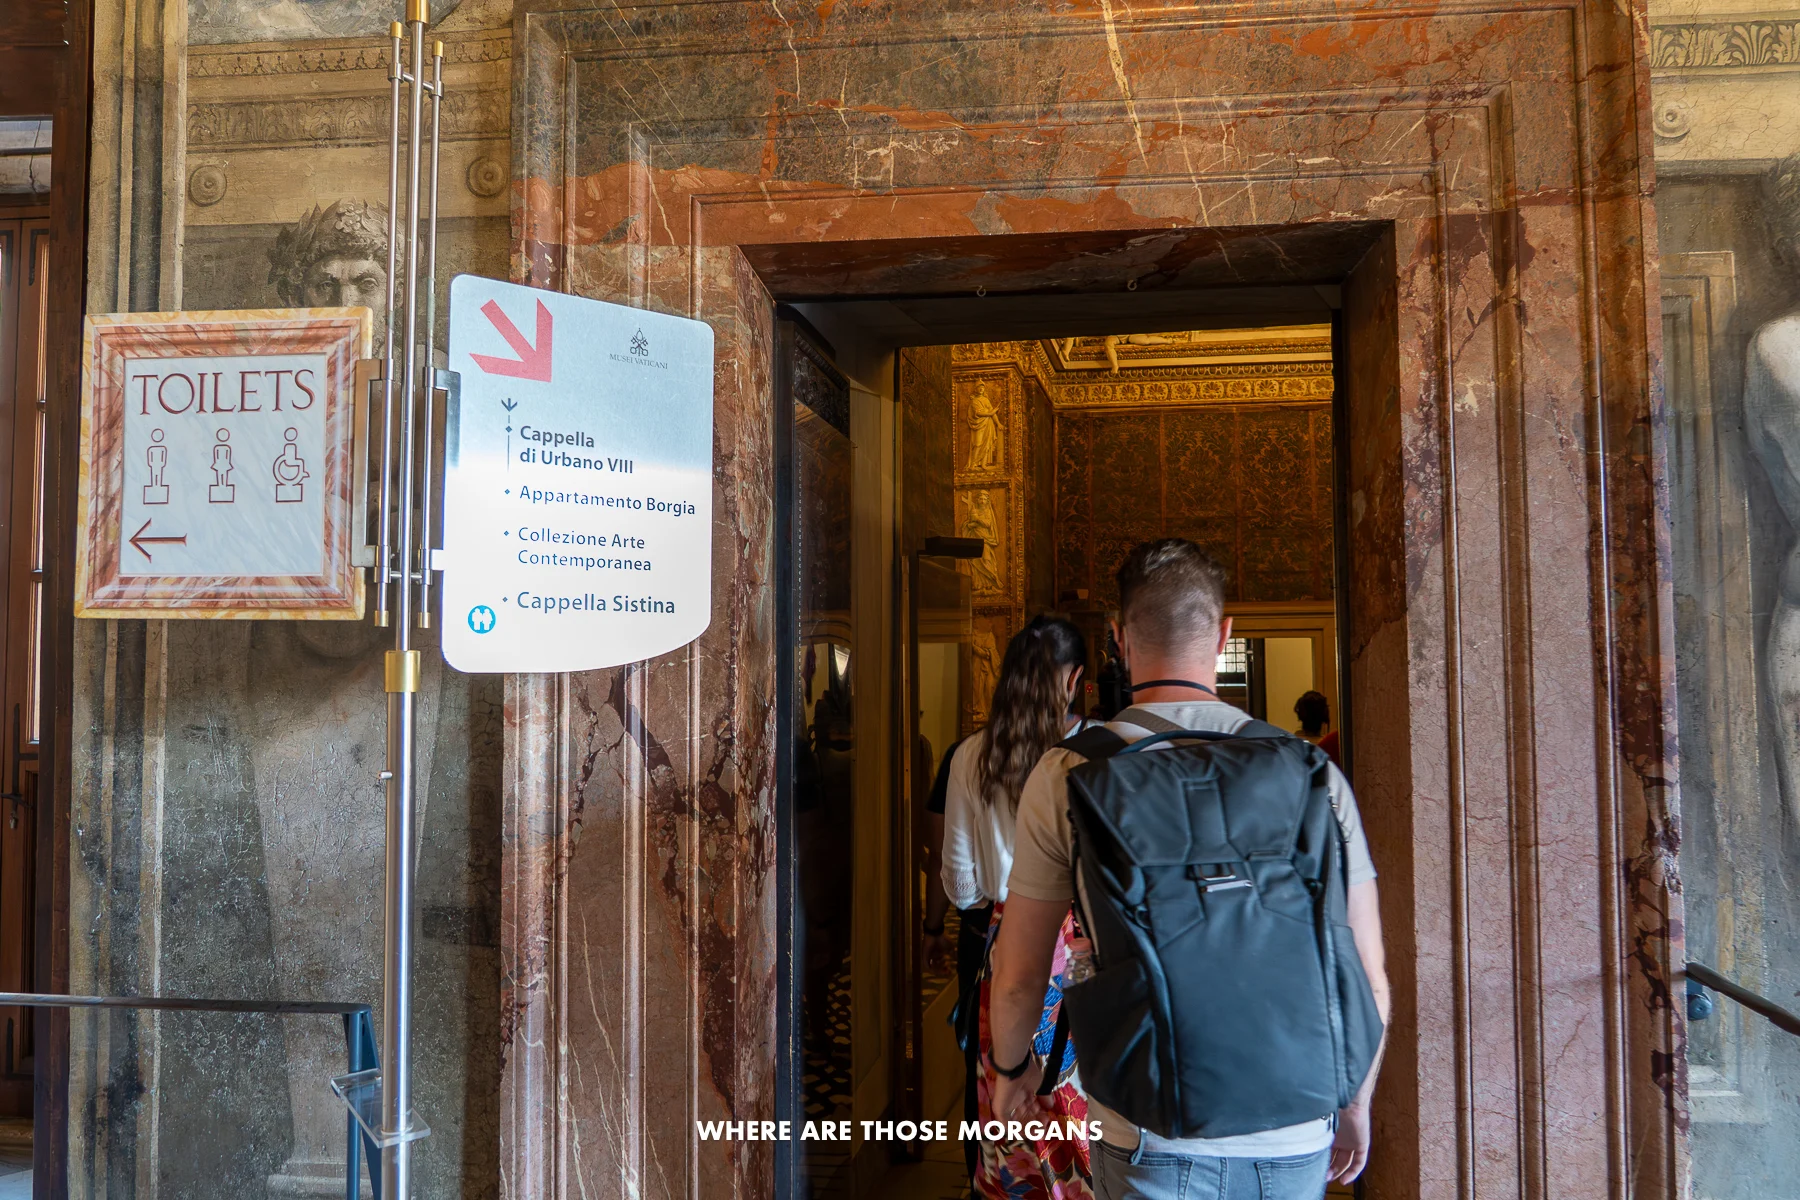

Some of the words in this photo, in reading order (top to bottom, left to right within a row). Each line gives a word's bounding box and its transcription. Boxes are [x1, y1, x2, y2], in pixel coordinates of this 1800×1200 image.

[609, 353, 633, 364] MUSEI
[634, 357, 668, 370] VATICANI
[132, 369, 315, 415] TOILETS
[520, 425, 595, 448] Cappella
[520, 448, 536, 464] di
[541, 450, 604, 471] Urbano
[607, 457, 633, 474] VIII
[519, 485, 642, 510] Appartamento
[646, 498, 696, 517] Borgia
[518, 527, 607, 547] Collezione
[611, 534, 645, 549] Arte
[518, 550, 652, 571] Contemporanea
[517, 591, 606, 614] Cappella
[612, 595, 675, 614] Sistina
